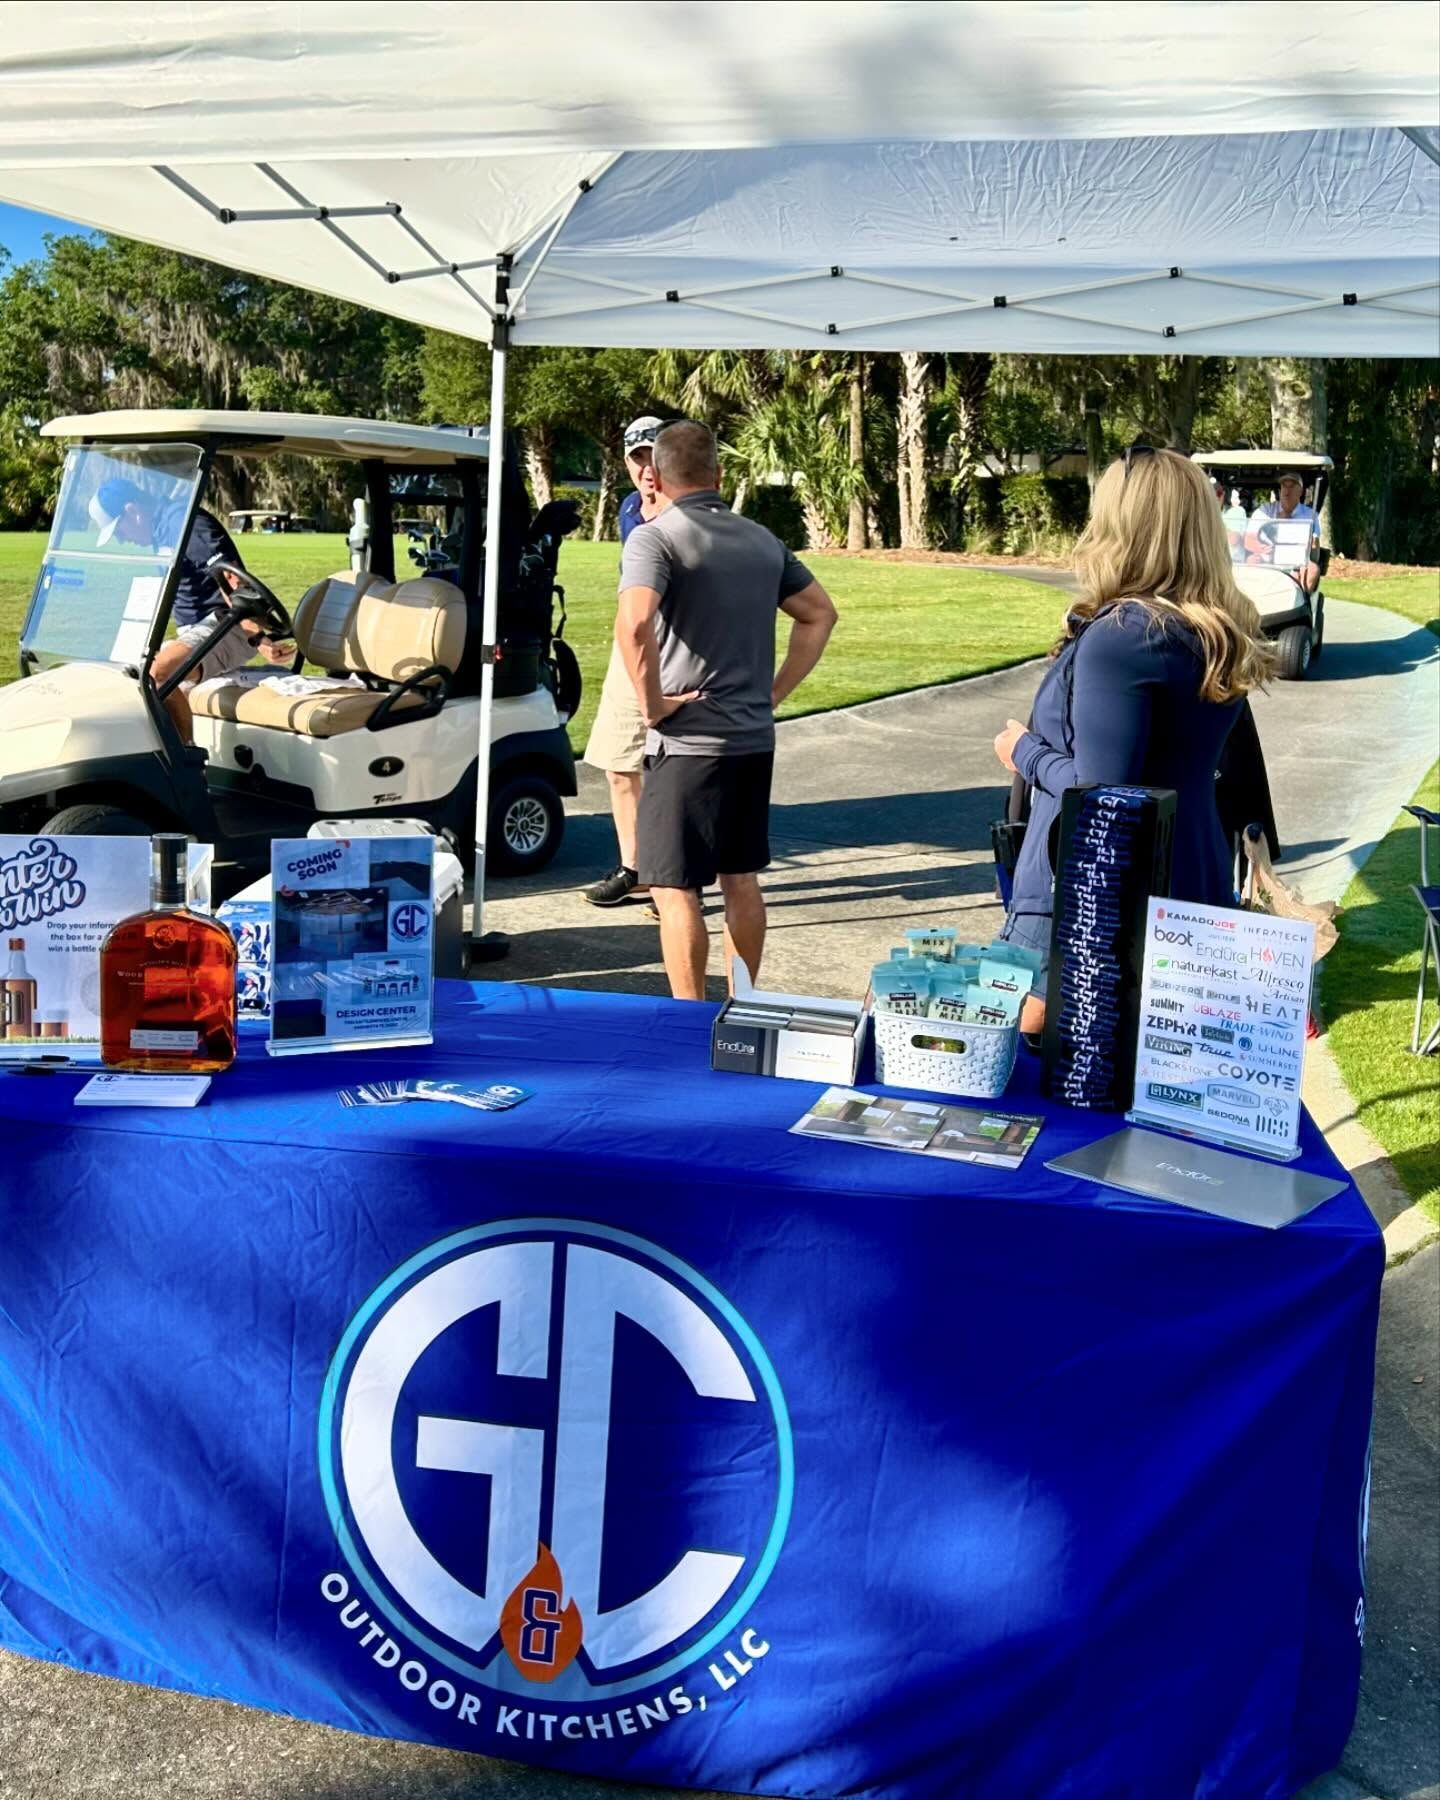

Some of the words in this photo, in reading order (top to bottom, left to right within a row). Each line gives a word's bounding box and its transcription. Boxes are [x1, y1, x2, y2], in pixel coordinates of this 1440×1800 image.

[0, 838, 77, 898] nter
[287, 849, 342, 873] COMING
[297, 861, 337, 880] SOON
[47, 921, 67, 931] Drop
[69, 923, 87, 931] your
[922, 938, 945, 946] MIX
[1154, 925, 1194, 947] best
[72, 945, 97, 953] bottle
[1171, 958, 1238, 981] naturekast
[336, 1007, 375, 1019] DESIGN
[376, 1005, 417, 1016] CENTER
[887, 1000, 925, 1009] TRAIL
[935, 1004, 964, 1015] TRAI
[1150, 998, 1185, 1013] SUMMIT
[939, 1011, 963, 1020] MIX
[1200, 1005, 1242, 1022] BLAZE
[1151, 1057, 1214, 1077] BLACKSTONE
[1218, 1062, 1296, 1092] COYOTE
[1163, 1086, 1199, 1104] LYNX
[1211, 1086, 1254, 1105] MARVEL
[1207, 1108, 1250, 1123] SEDONA
[320, 1572, 482, 1727] OUTDOOR
[496, 1684, 708, 1742] KITCHENS,
[707, 1627, 771, 1691] LLC
